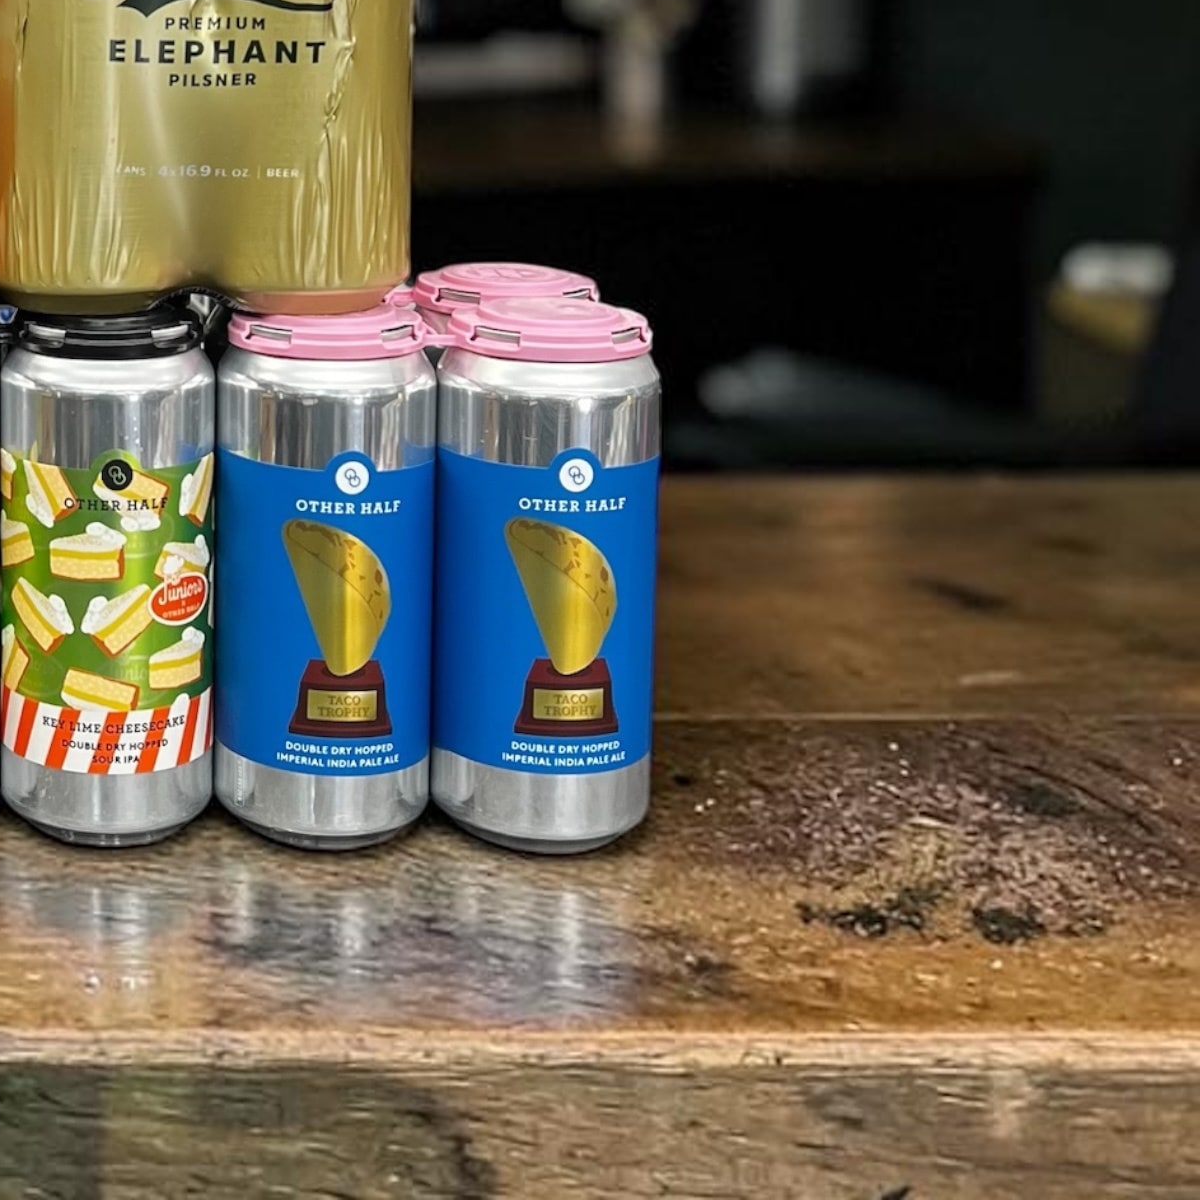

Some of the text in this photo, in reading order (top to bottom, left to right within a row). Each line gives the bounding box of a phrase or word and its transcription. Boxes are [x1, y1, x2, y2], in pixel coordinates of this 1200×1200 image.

[165, 17, 266, 30] PREMIUM
[109, 39, 327, 65] ELEPHANT
[168, 73, 257, 87] PILSNER
[215, 168, 227, 177] FL
[231, 168, 249, 177] OZ
[266, 167, 299, 178] BEER
[64, 496, 169, 511] OTHER HALF
[295, 498, 401, 515] OTHER HALF
[518, 497, 627, 513] OTHER HALF
[328, 695, 361, 706] TACO
[554, 693, 588, 705] TACO
[317, 706, 370, 718] TROPHY
[543, 704, 598, 717] TROPHY
[42, 714, 186, 734] KEY LIME CHEESECAKE
[61, 738, 169, 751] DOUBLE DRY HOPPED
[285, 740, 394, 756] DOUBLE DRY HOPPED
[511, 740, 620, 754] DOUBLE DRY HOPPED
[92, 754, 140, 764] SOUR IPA
[276, 751, 400, 768] IMPERIAL INDIA PALE ALE
[501, 750, 626, 767] IMPERIAL INDIA PALE ALE
